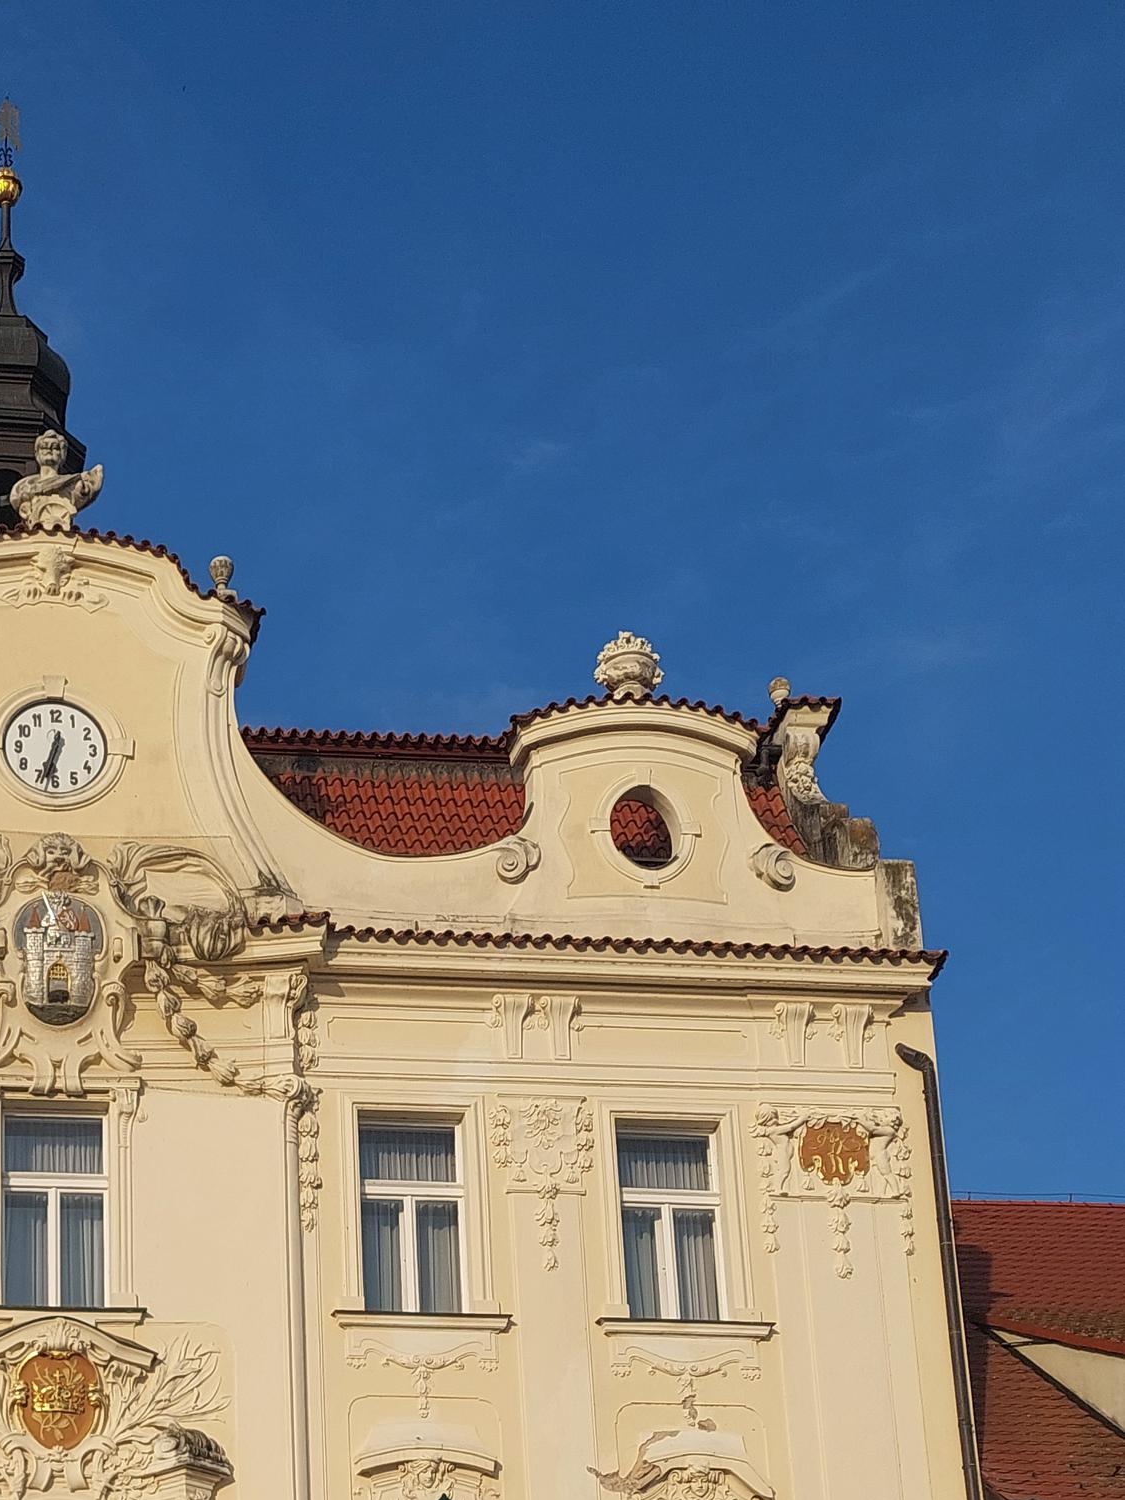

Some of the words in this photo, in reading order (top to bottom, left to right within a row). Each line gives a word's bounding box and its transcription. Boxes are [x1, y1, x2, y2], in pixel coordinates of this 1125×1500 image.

[32, 713, 41, 728] 11
[49, 709, 62, 723] 12
[70, 714, 76, 728] 1
[18, 724, 31, 738] 10
[83, 727, 92, 741] 2
[14, 740, 23, 753] 9
[88, 744, 97, 757] 3
[19, 757, 28, 770] 8
[83, 760, 92, 774] 4
[35, 769, 43, 783] 7
[51, 774, 60, 788] 6
[69, 771, 78, 785] 5
